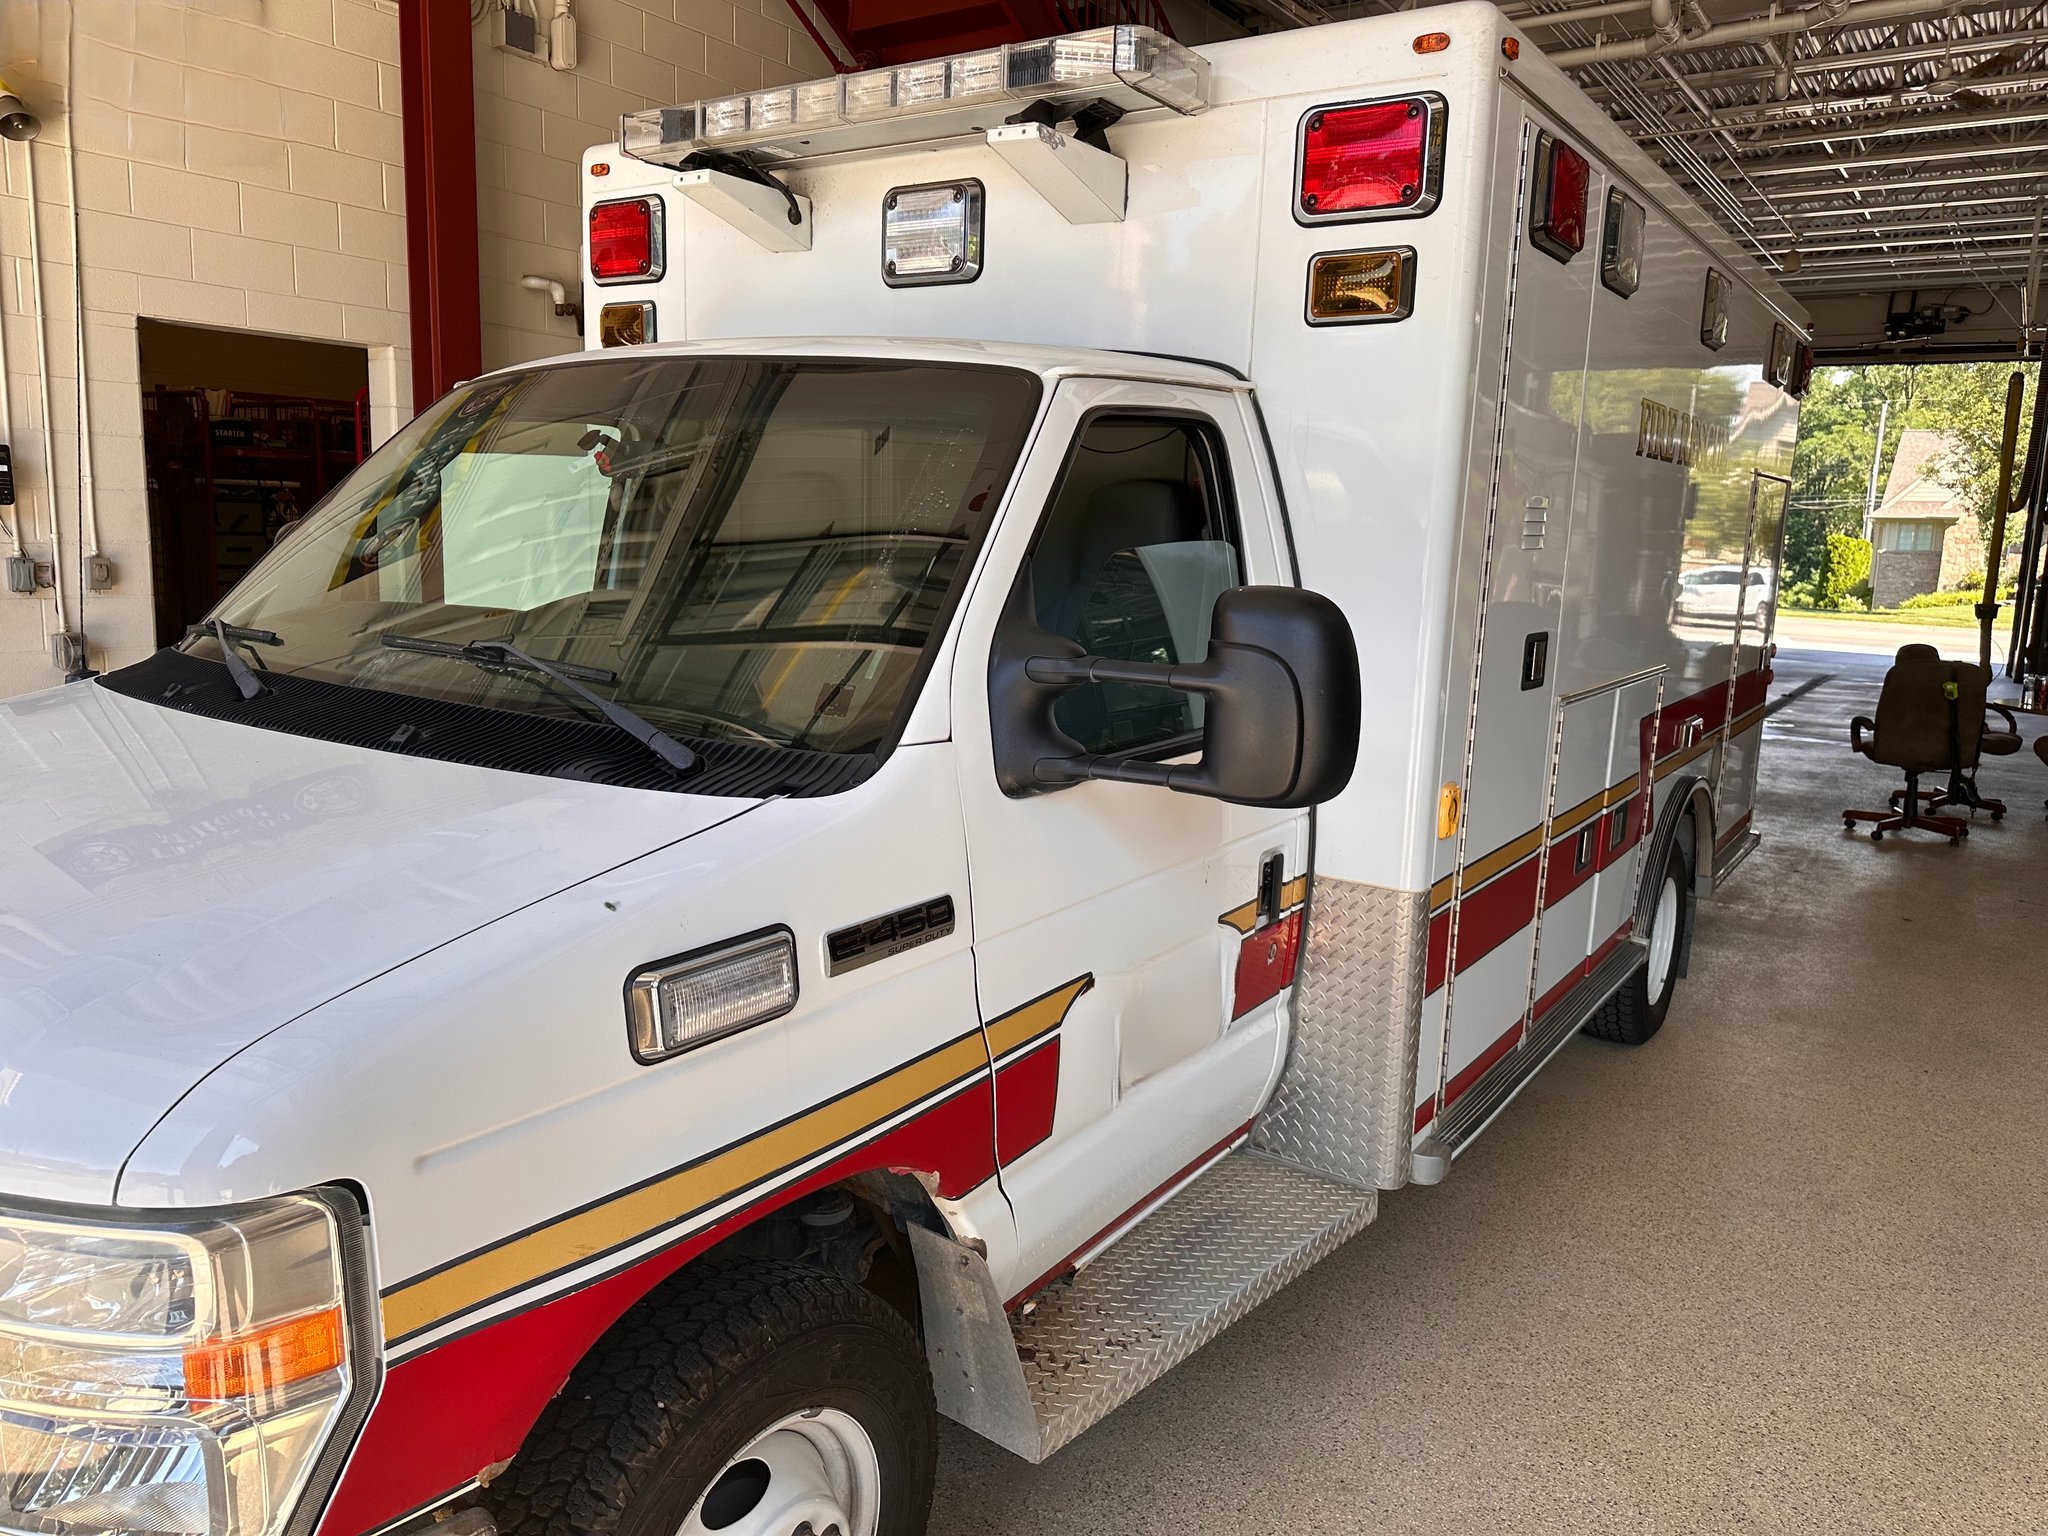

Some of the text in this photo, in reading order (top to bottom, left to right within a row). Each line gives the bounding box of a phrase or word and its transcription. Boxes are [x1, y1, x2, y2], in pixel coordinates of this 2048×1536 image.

[214, 429, 245, 438] STARTER
[1635, 397, 1679, 463] FIRE
[828, 899, 953, 962] E-450
[887, 926, 952, 956] SUPER DUTY
